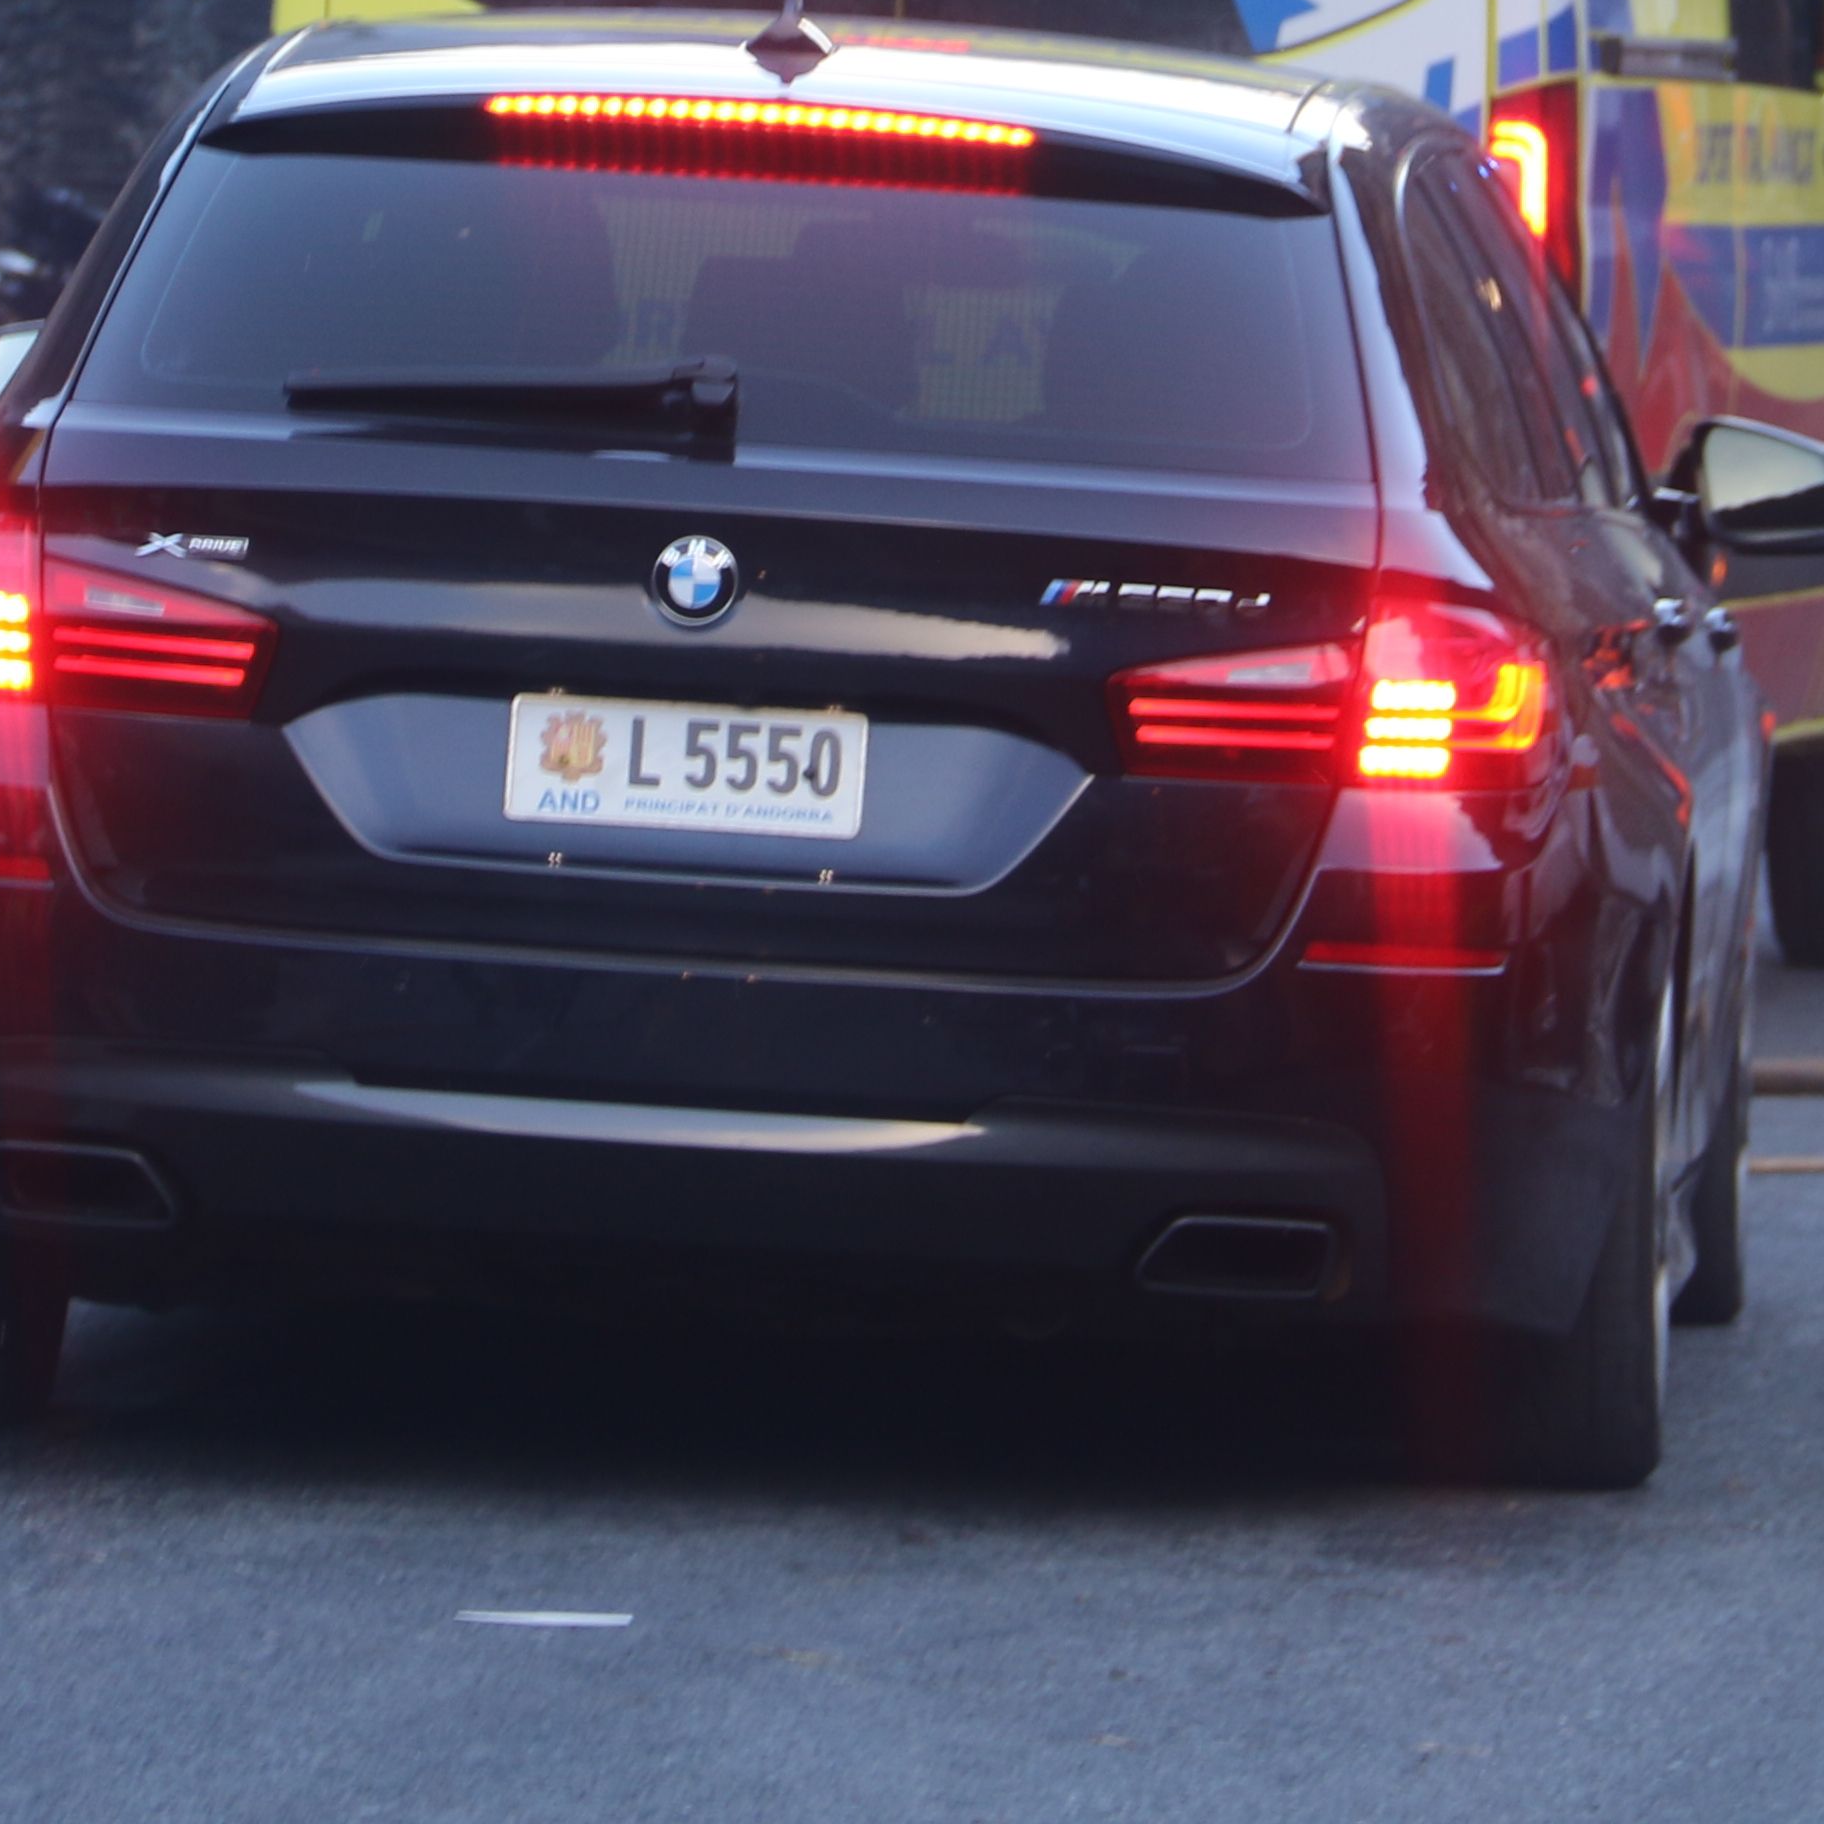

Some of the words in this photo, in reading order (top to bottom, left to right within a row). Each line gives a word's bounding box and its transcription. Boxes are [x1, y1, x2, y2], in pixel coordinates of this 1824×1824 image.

[628, 716, 660, 787] L
[684, 719, 843, 798] 5550
[537, 787, 603, 815] AND
[623, 797, 718, 818] PRINCIPAT
[725, 804, 834, 824] D'ANDORRA
